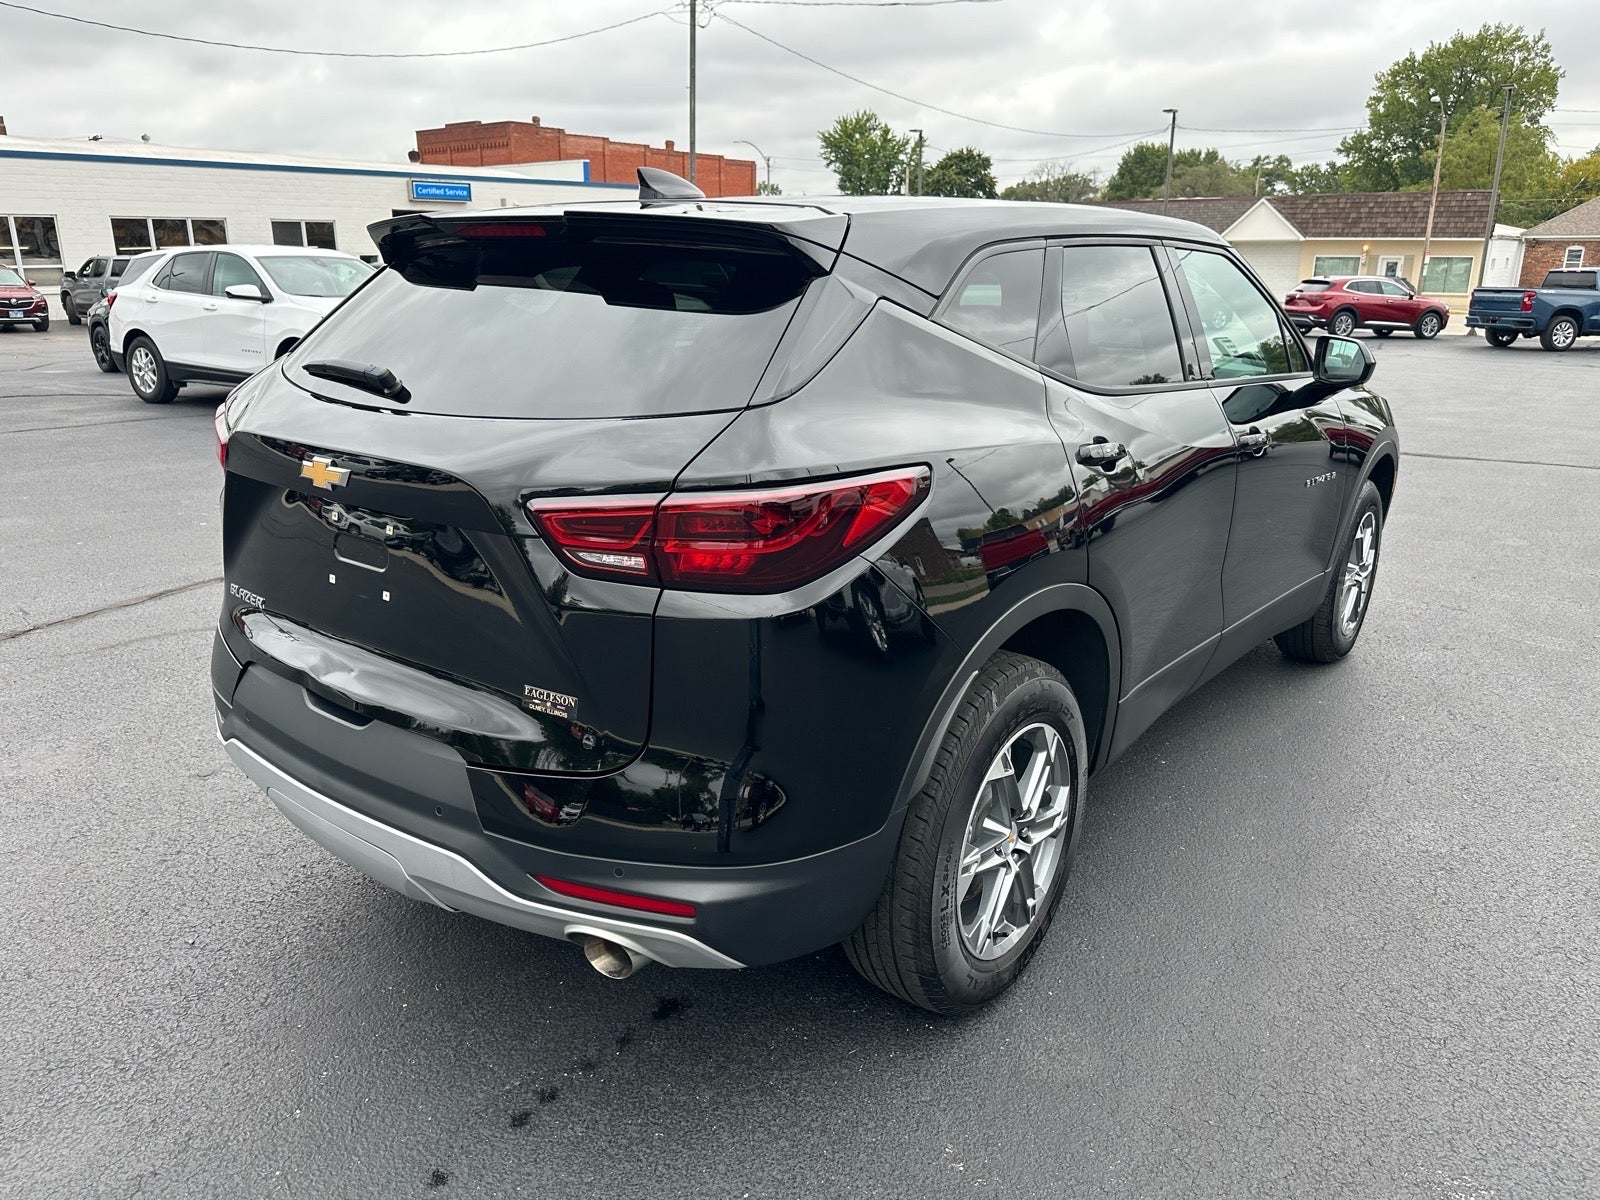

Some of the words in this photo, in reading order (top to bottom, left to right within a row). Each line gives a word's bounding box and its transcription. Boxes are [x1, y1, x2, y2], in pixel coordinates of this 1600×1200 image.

[417, 186, 445, 195] Certified
[445, 188, 468, 196] Service
[230, 583, 266, 609] BLAZER
[524, 686, 576, 708] EAGLESON
[528, 703, 547, 714] OLNEY,
[547, 708, 568, 719] ILLINOIS
